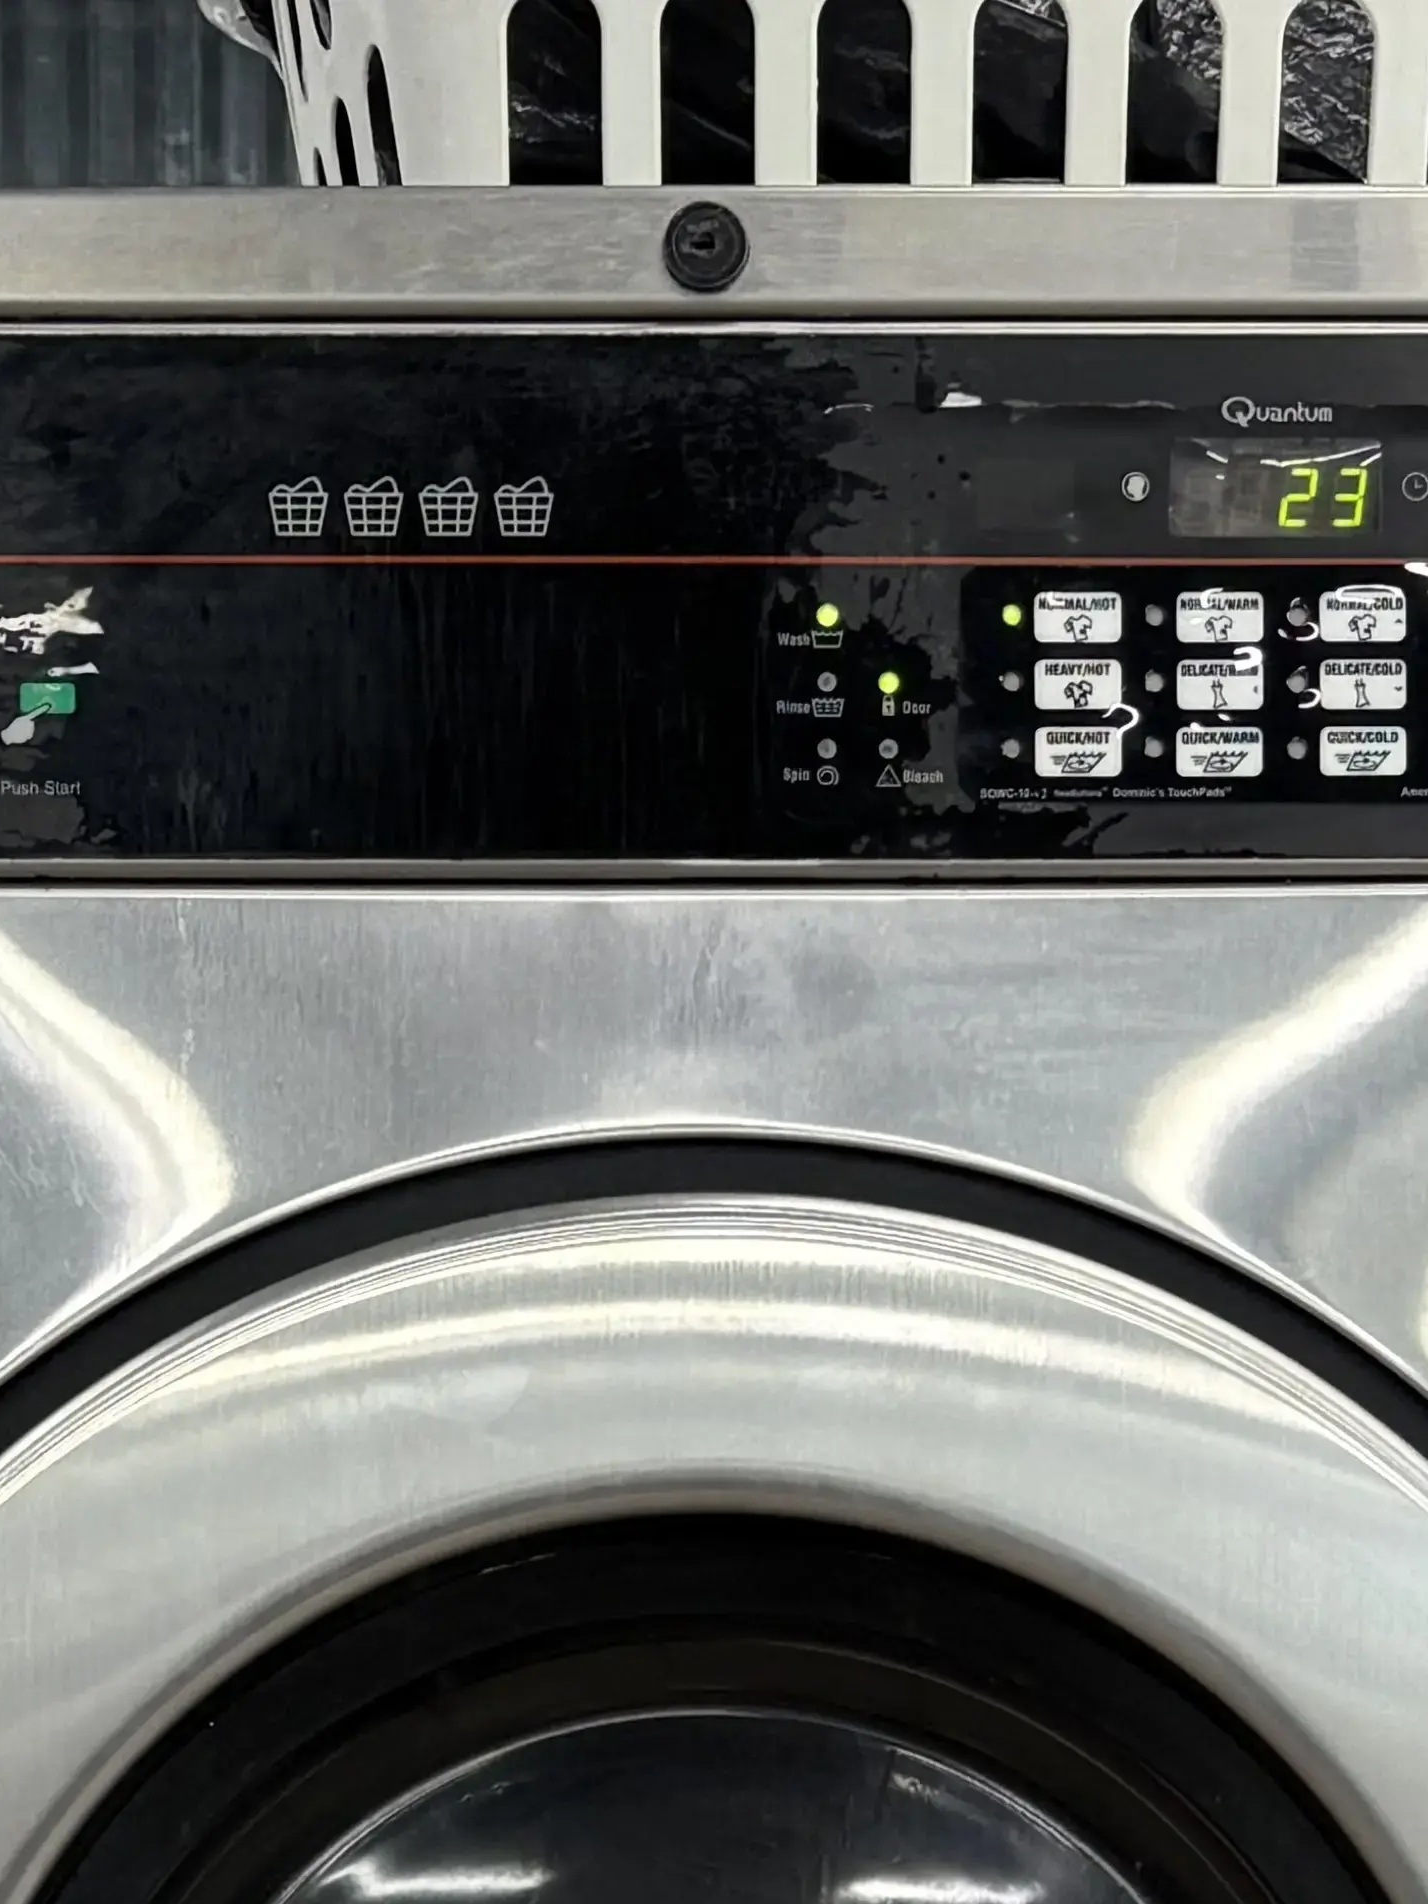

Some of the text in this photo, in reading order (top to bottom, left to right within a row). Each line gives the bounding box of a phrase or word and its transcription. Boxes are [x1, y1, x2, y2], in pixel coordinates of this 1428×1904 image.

[1222, 396, 1332, 427] Quantum
[1279, 469, 1367, 527] 23
[778, 633, 810, 646] Wash
[1045, 663, 1111, 676] HEAVY/HOT
[1325, 662, 1402, 676] DELICATE/COLD
[776, 701, 810, 714] Rinse
[903, 701, 931, 714] Door
[1046, 732, 1110, 744] QUICK/HOT
[1182, 732, 1260, 744] QUICK/WARM
[1327, 731, 1398, 744] QUICK/COLD
[783, 768, 809, 783] Spin
[903, 770, 943, 783] Bleach
[1, 780, 81, 795] Push Start
